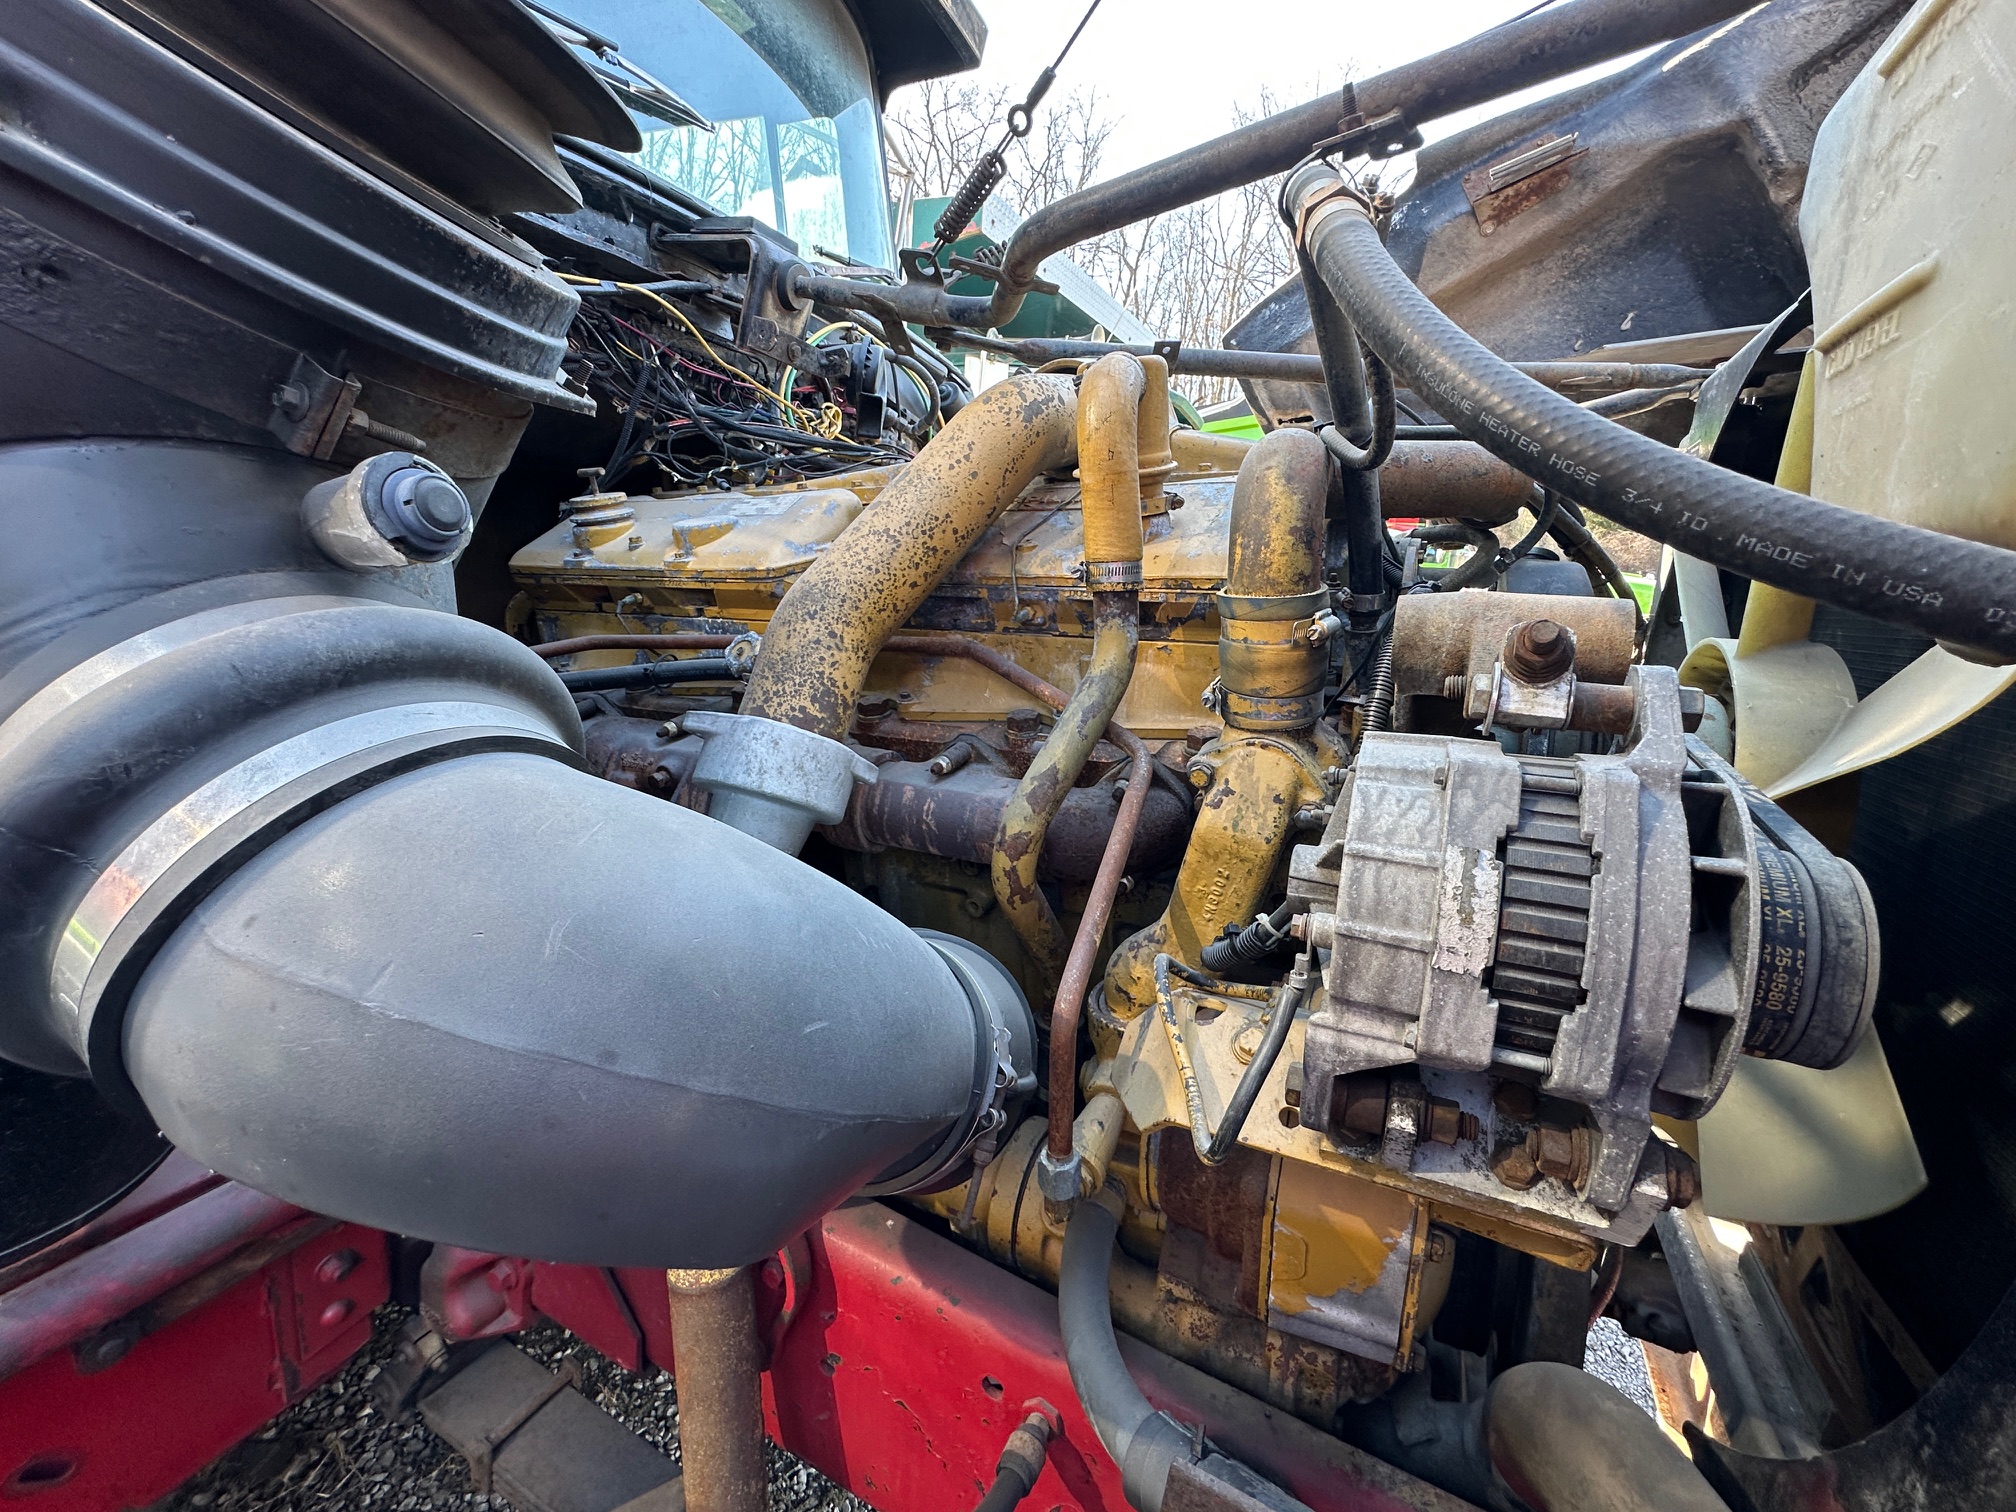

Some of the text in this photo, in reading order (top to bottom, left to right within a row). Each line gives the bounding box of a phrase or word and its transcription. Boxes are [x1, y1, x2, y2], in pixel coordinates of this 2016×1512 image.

[1479, 411, 1541, 457] HEATER
[1549, 453, 1601, 487] HOSE
[1622, 488, 1662, 514] 3/4
[1736, 533, 1814, 569] MADE
[1831, 562, 1866, 586] IN
[1882, 579, 1944, 607] USA
[1757, 849, 1792, 903] PREMIUM
[1765, 945, 1793, 1011] 25-9580
